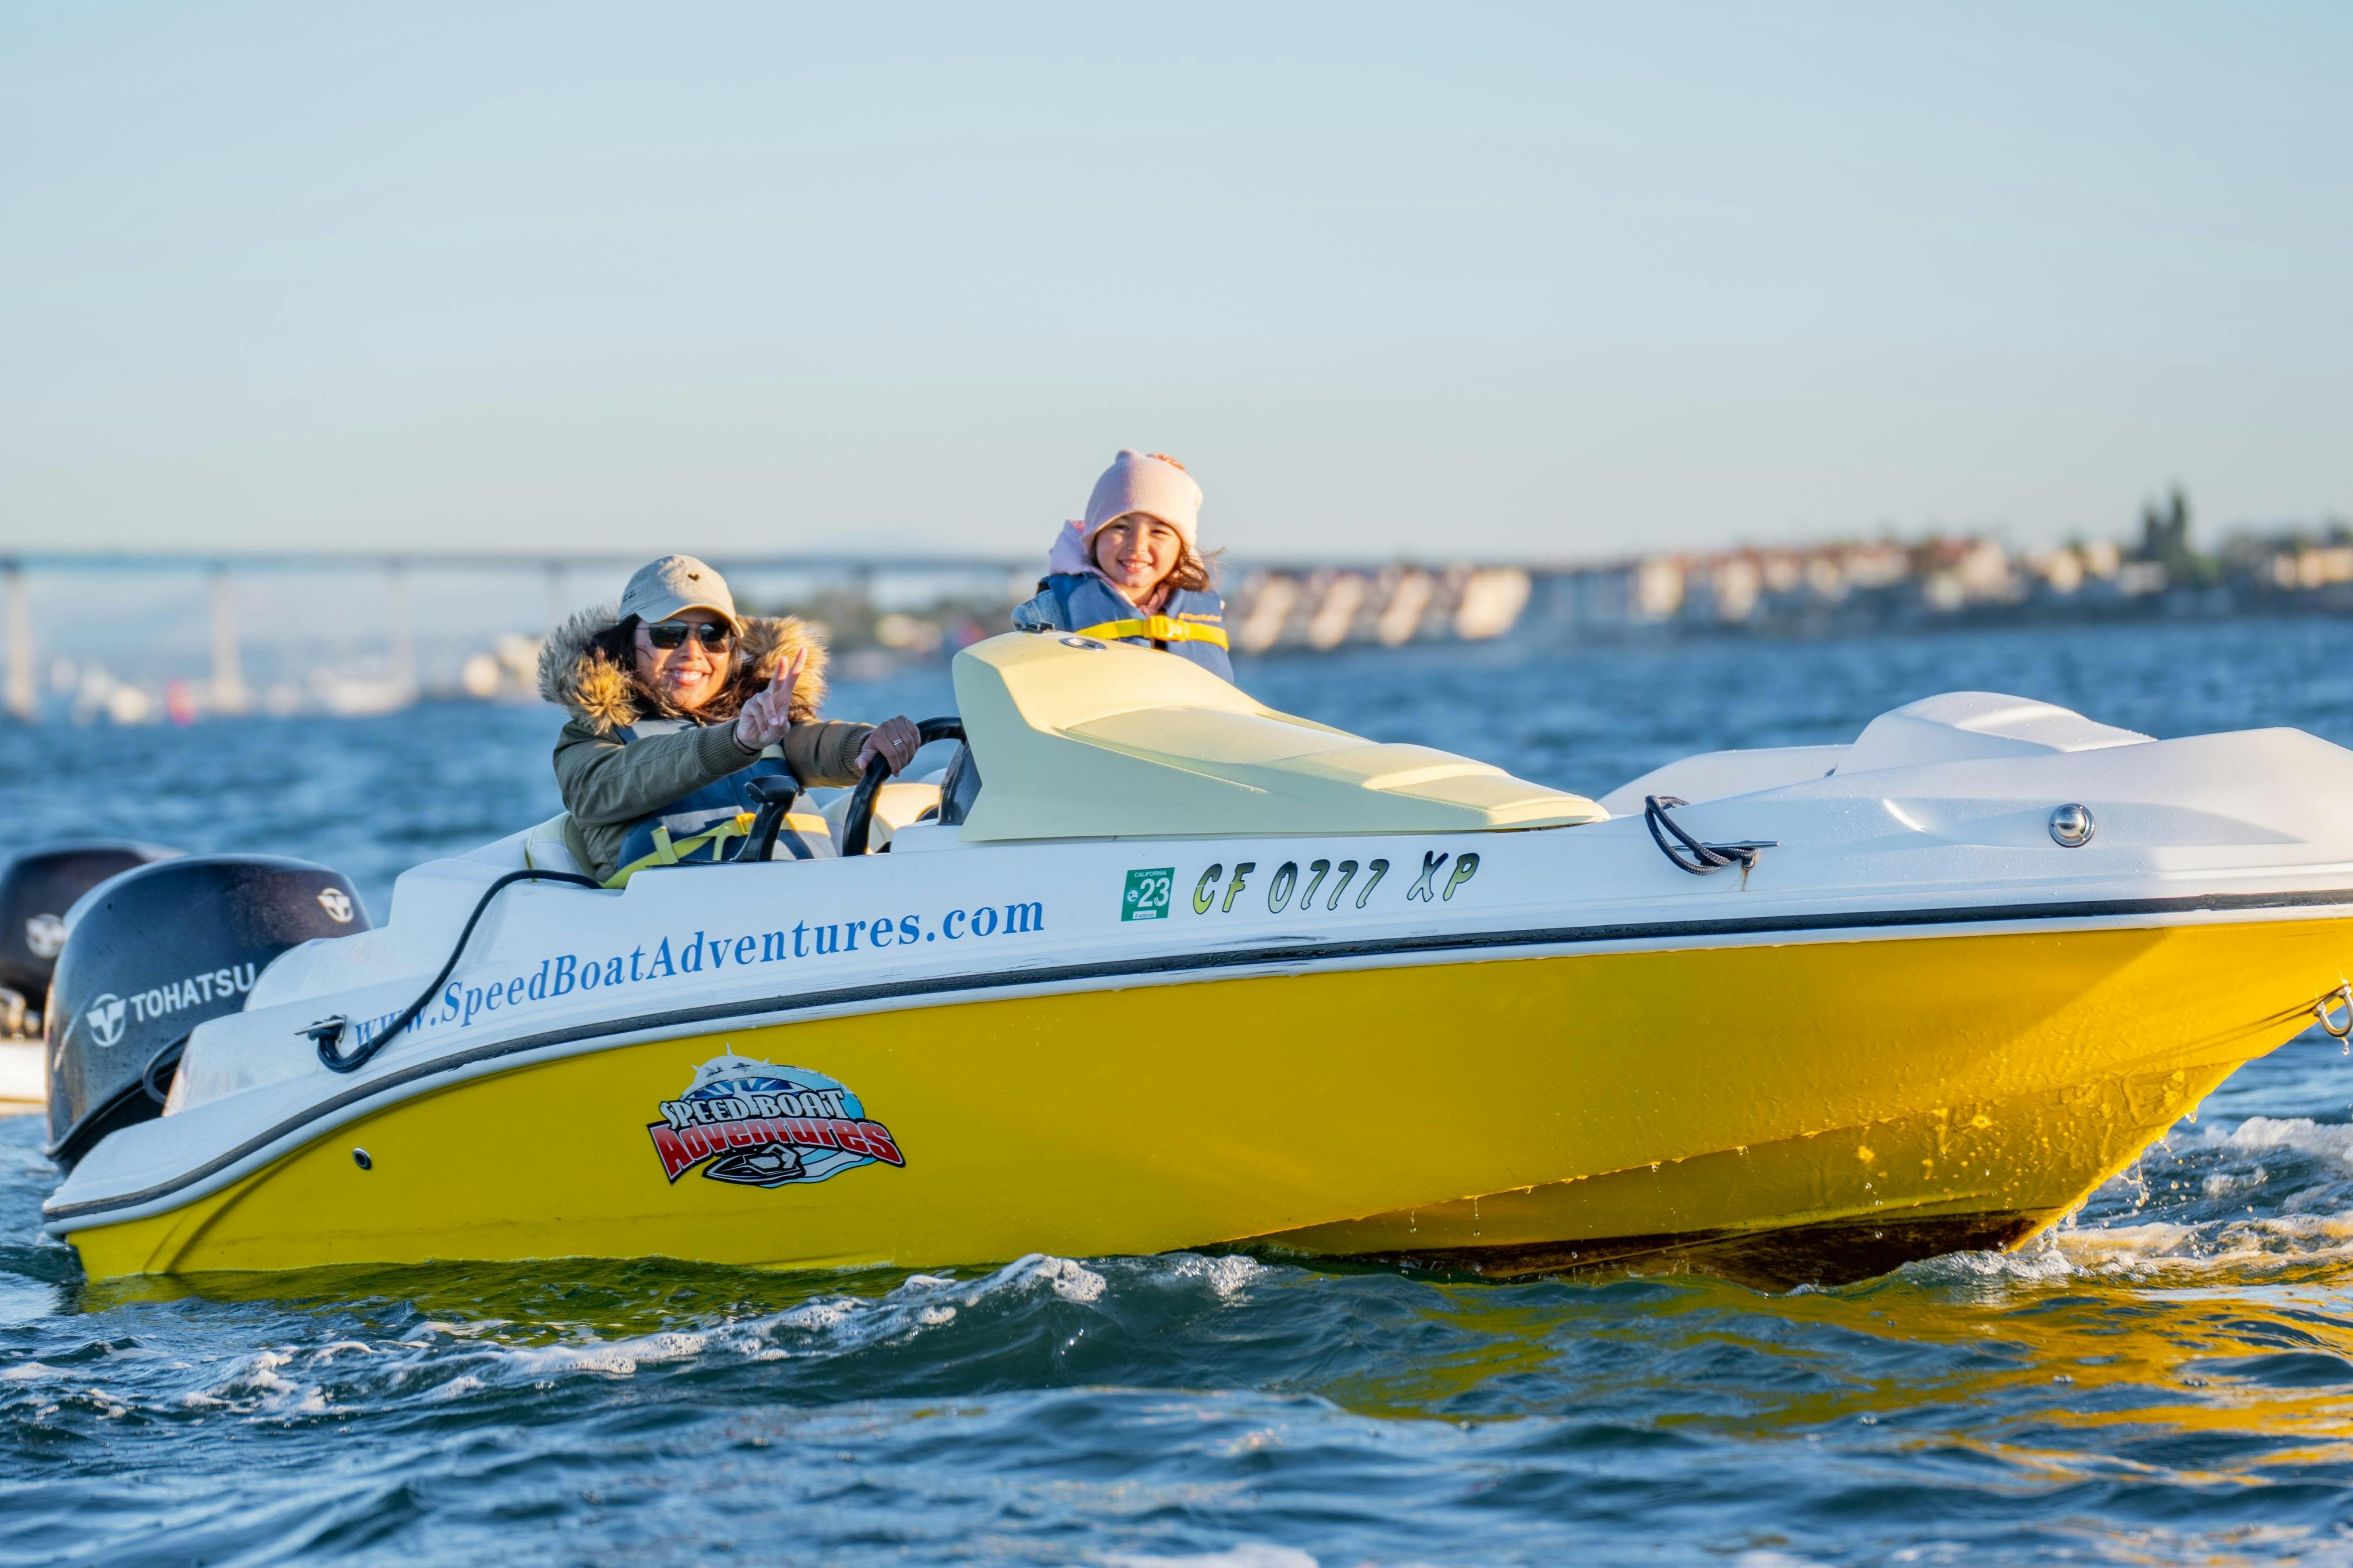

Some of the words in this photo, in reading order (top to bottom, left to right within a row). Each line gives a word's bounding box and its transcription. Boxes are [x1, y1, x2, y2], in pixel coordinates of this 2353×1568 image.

[1137, 877, 1170, 907] 23
[1193, 863, 1256, 914] CF
[1268, 859, 1390, 913] 0777
[1407, 851, 1480, 902] XP
[130, 963, 255, 1022] TOHATSU
[650, 1117, 904, 1180] Adventures
